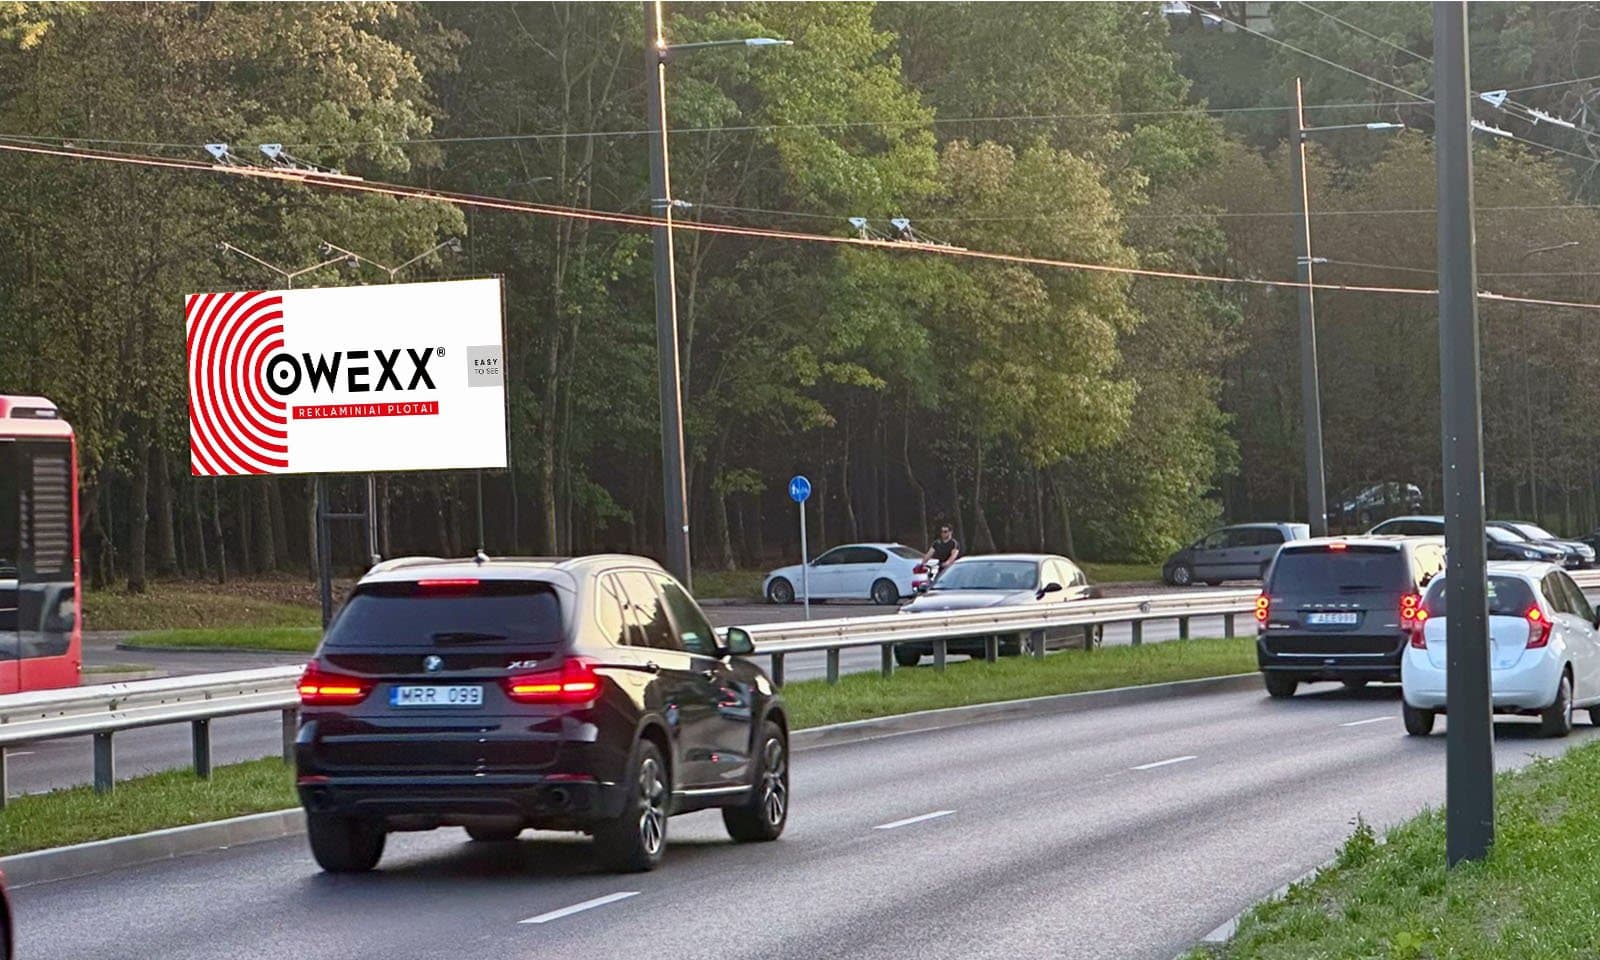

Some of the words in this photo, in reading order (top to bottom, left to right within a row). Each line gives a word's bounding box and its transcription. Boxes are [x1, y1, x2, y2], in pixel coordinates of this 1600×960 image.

[474, 358, 498, 366] EASY
[486, 367, 499, 375] SEE
[298, 405, 382, 418] REKLAMINIAI
[387, 402, 434, 415] PLOTAI
[447, 687, 479, 703] 099
